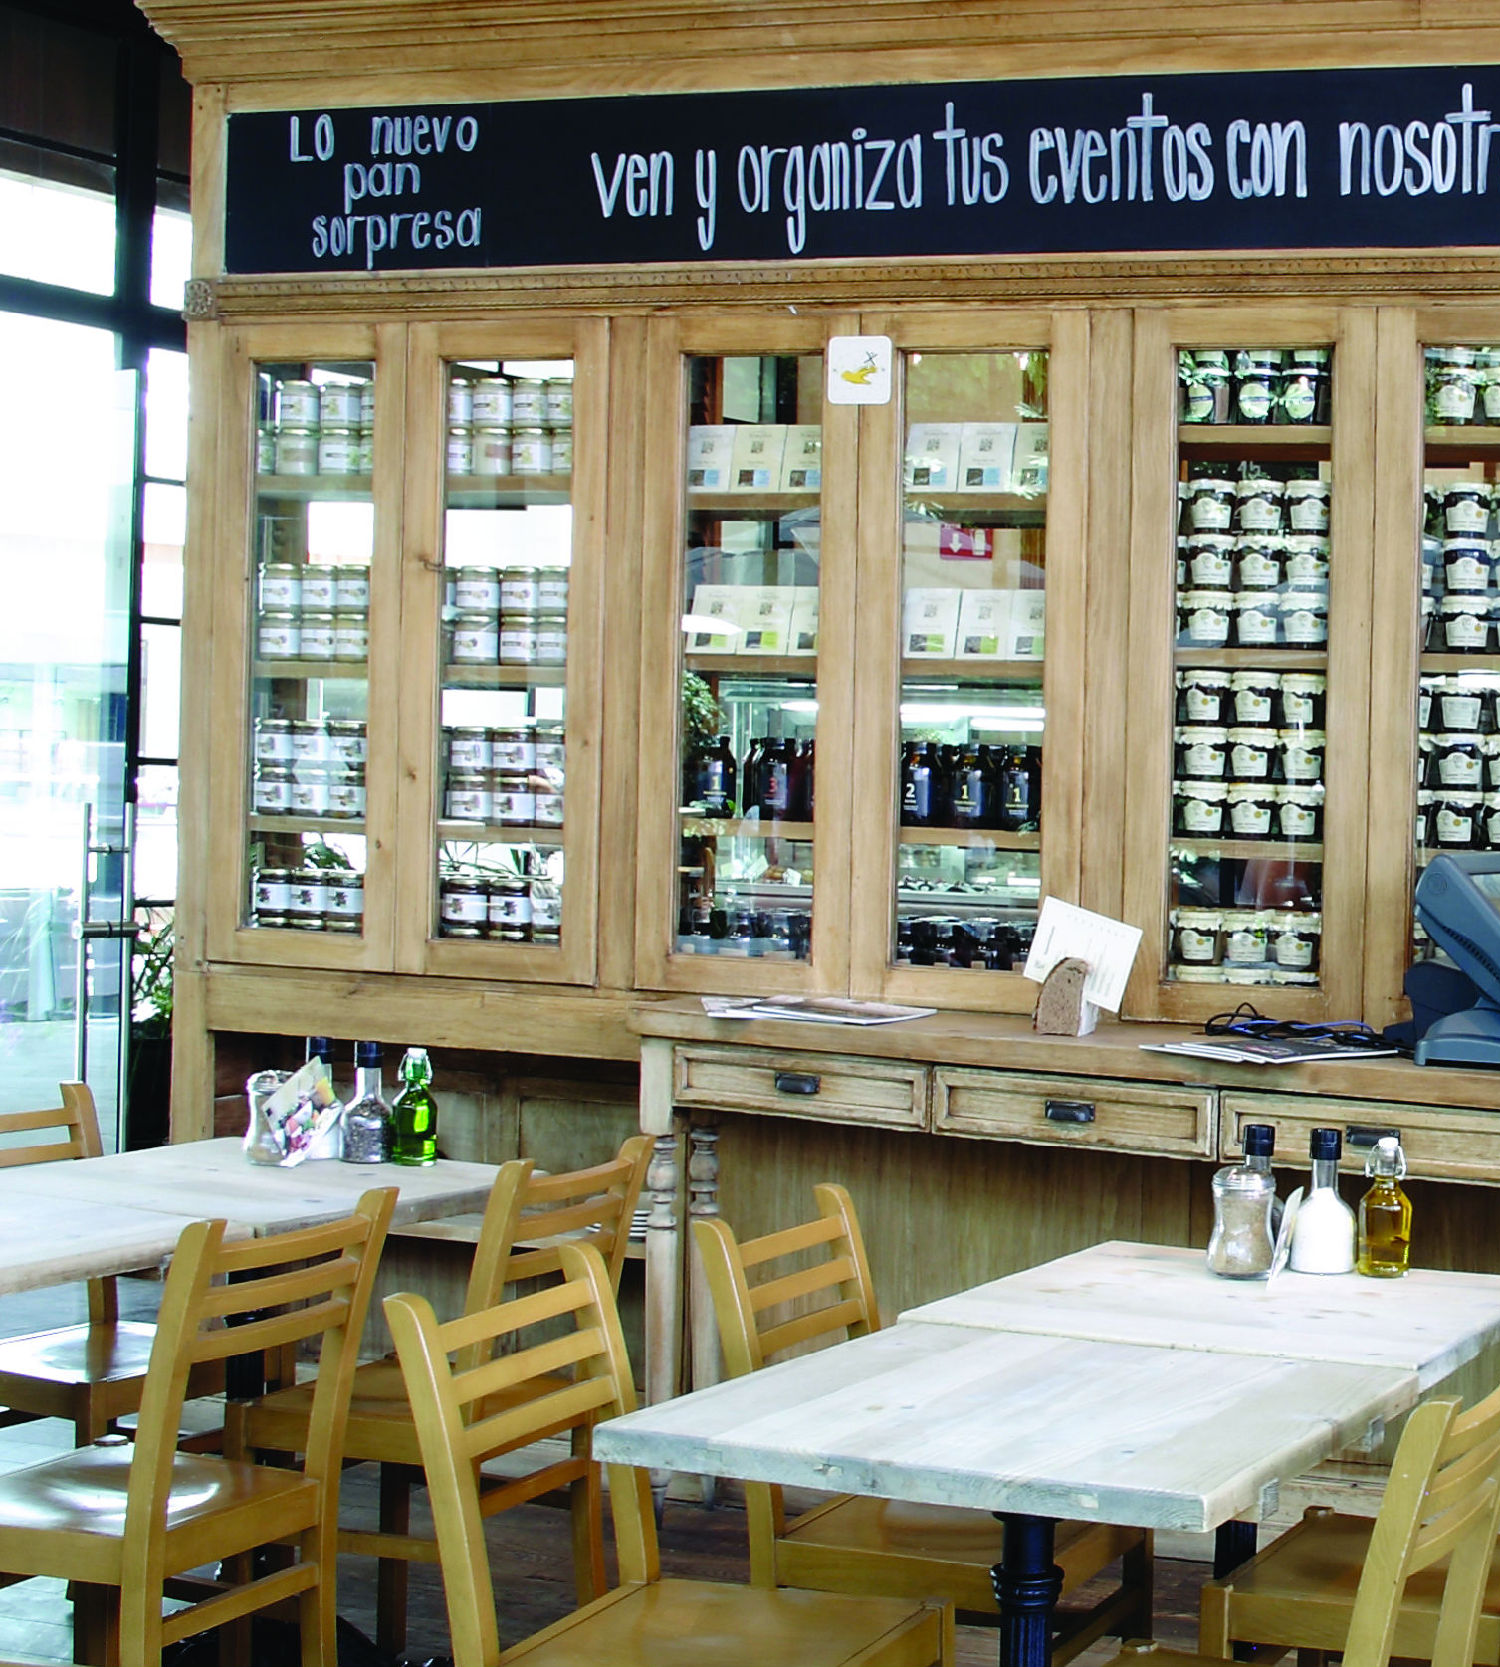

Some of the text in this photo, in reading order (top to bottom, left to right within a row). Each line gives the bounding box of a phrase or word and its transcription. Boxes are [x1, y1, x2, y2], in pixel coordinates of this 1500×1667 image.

[370, 114, 478, 157] nuevo
[343, 161, 419, 212] pan
[591, 151, 672, 218] ven
[696, 149, 715, 251] y
[738, 128, 920, 255] organiza
[933, 103, 1009, 205] tus
[1029, 93, 1213, 203] eventos
[1227, 119, 1307, 199] con
[312, 207, 481, 270] sorpresa
[905, 783, 916, 799] 2
[961, 785, 969, 799] 1
[1013, 787, 1021, 802] 1
